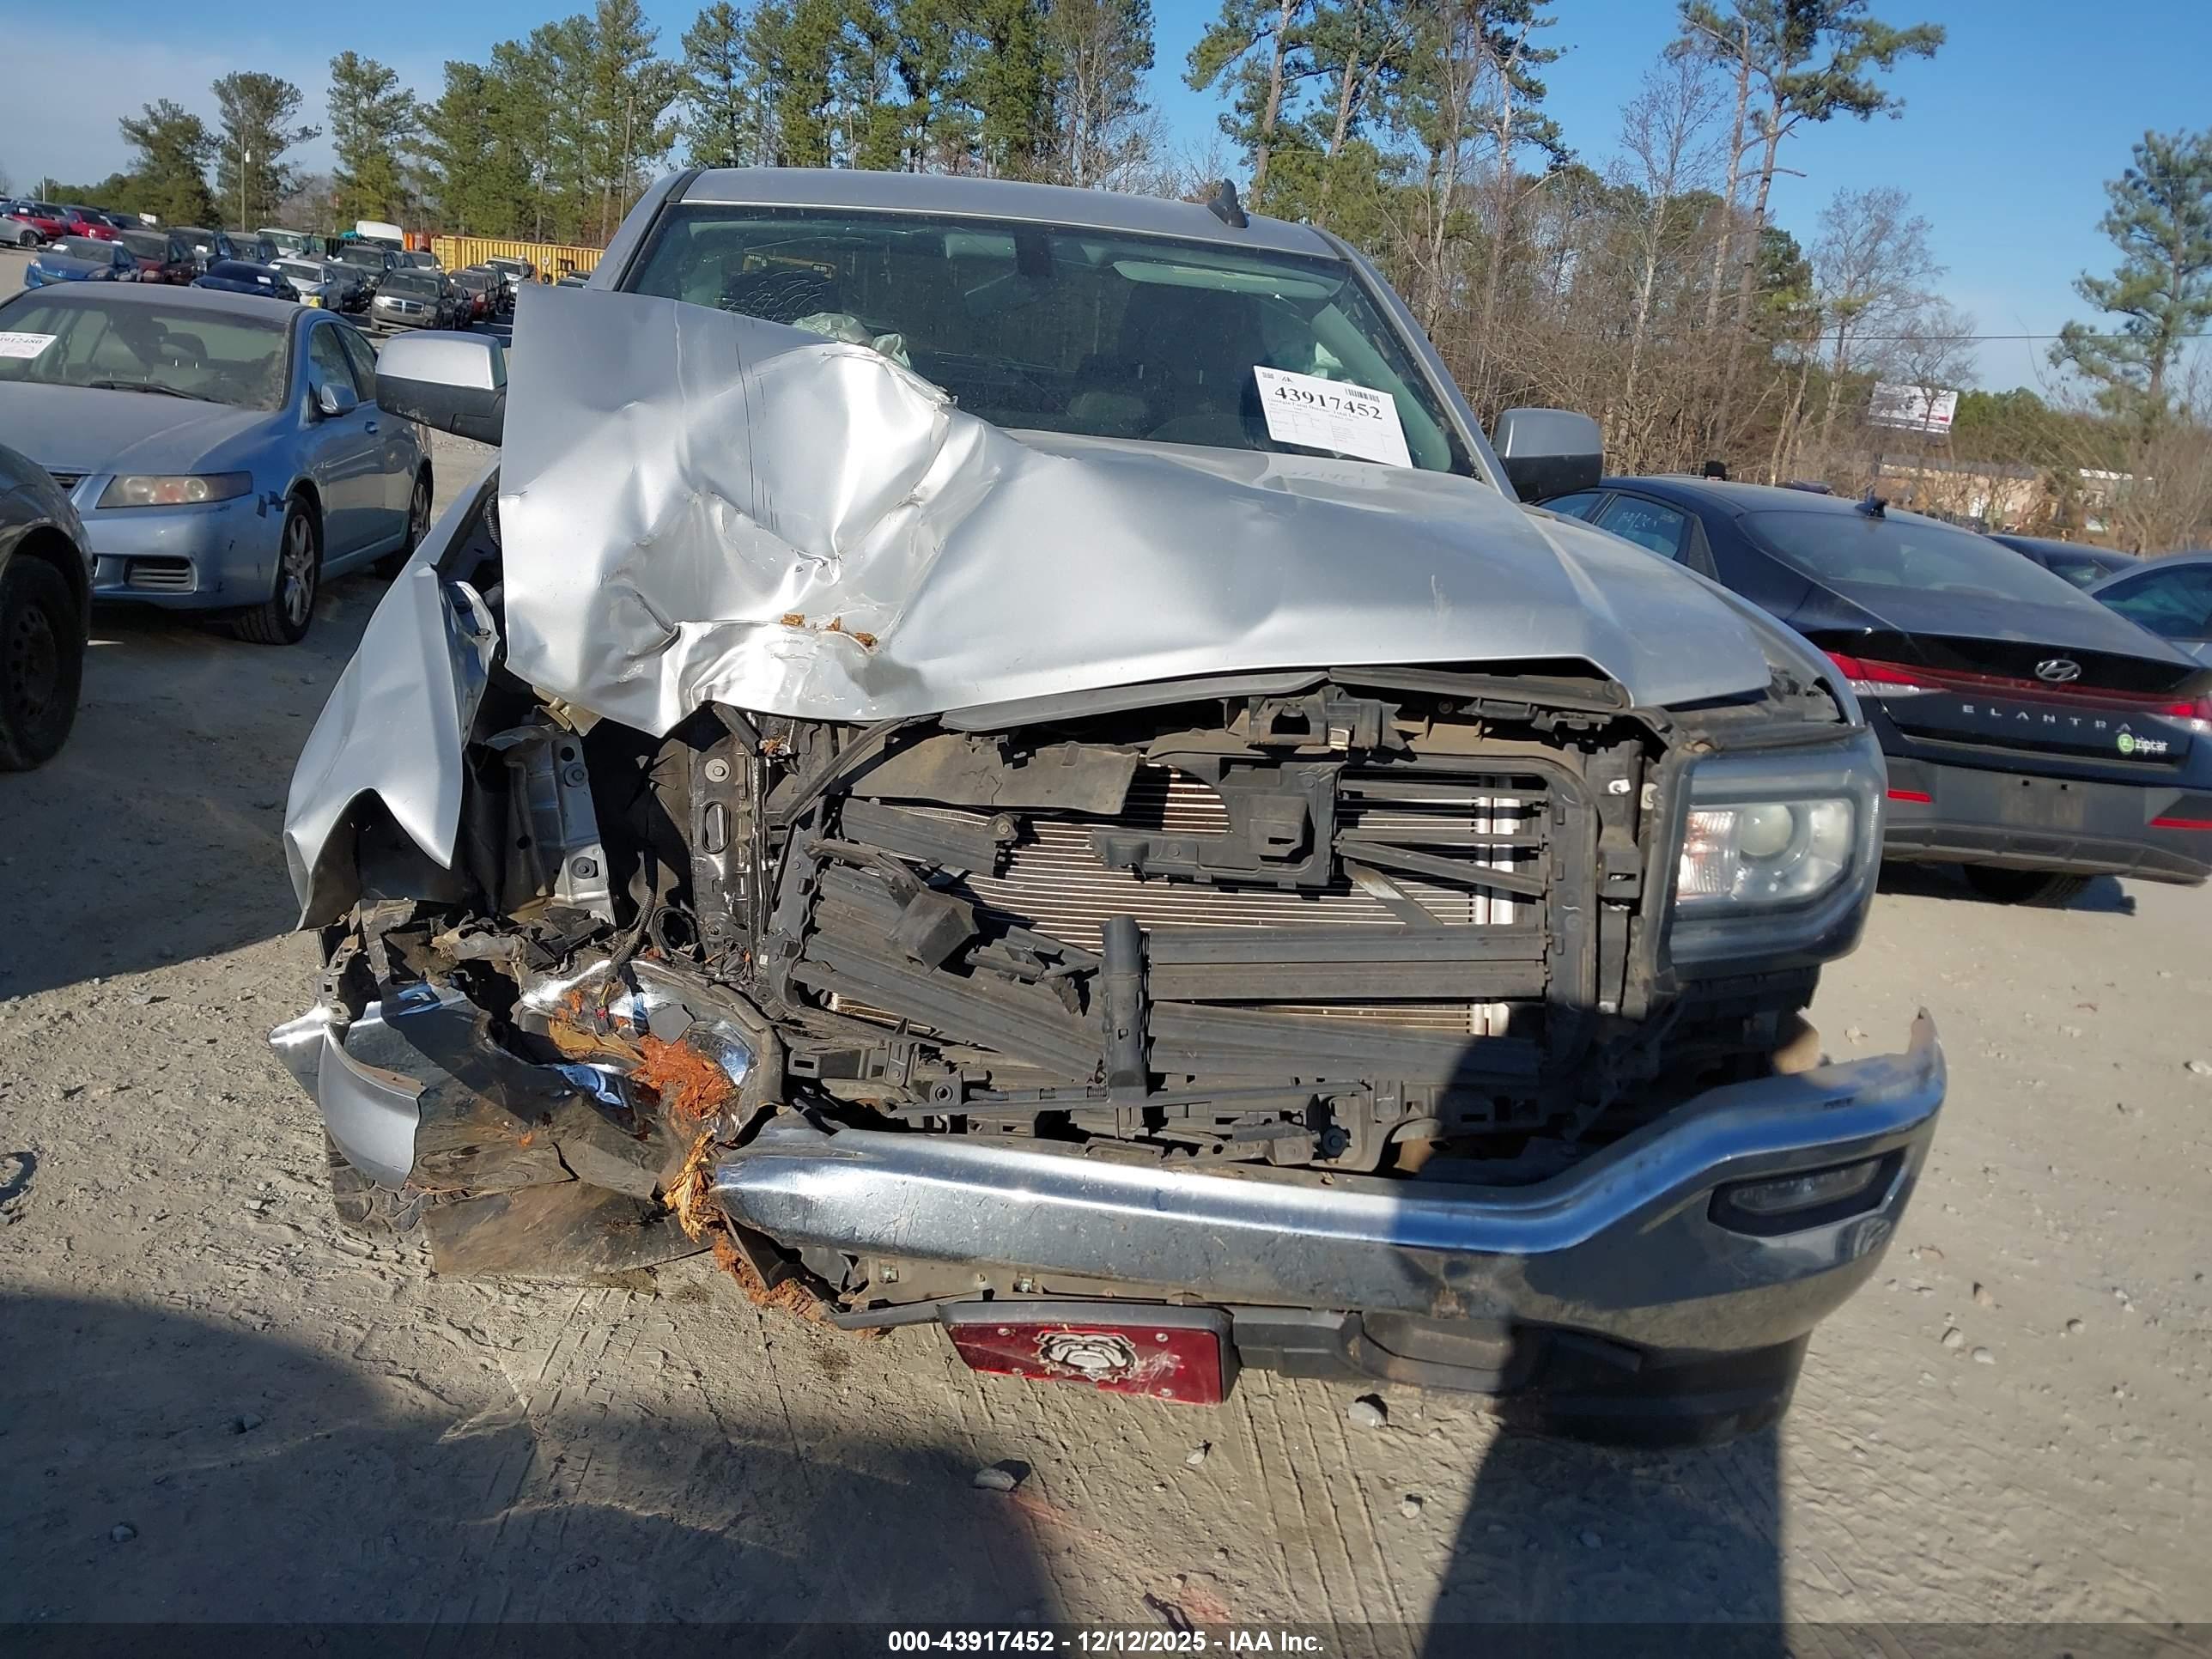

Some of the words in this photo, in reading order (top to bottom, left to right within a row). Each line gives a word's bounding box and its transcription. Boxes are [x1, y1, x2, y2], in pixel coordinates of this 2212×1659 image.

[1274, 386, 1383, 420] 43917452
[1962, 704, 2131, 732] ELANTRA
[2135, 736, 2169, 755] zipcar
